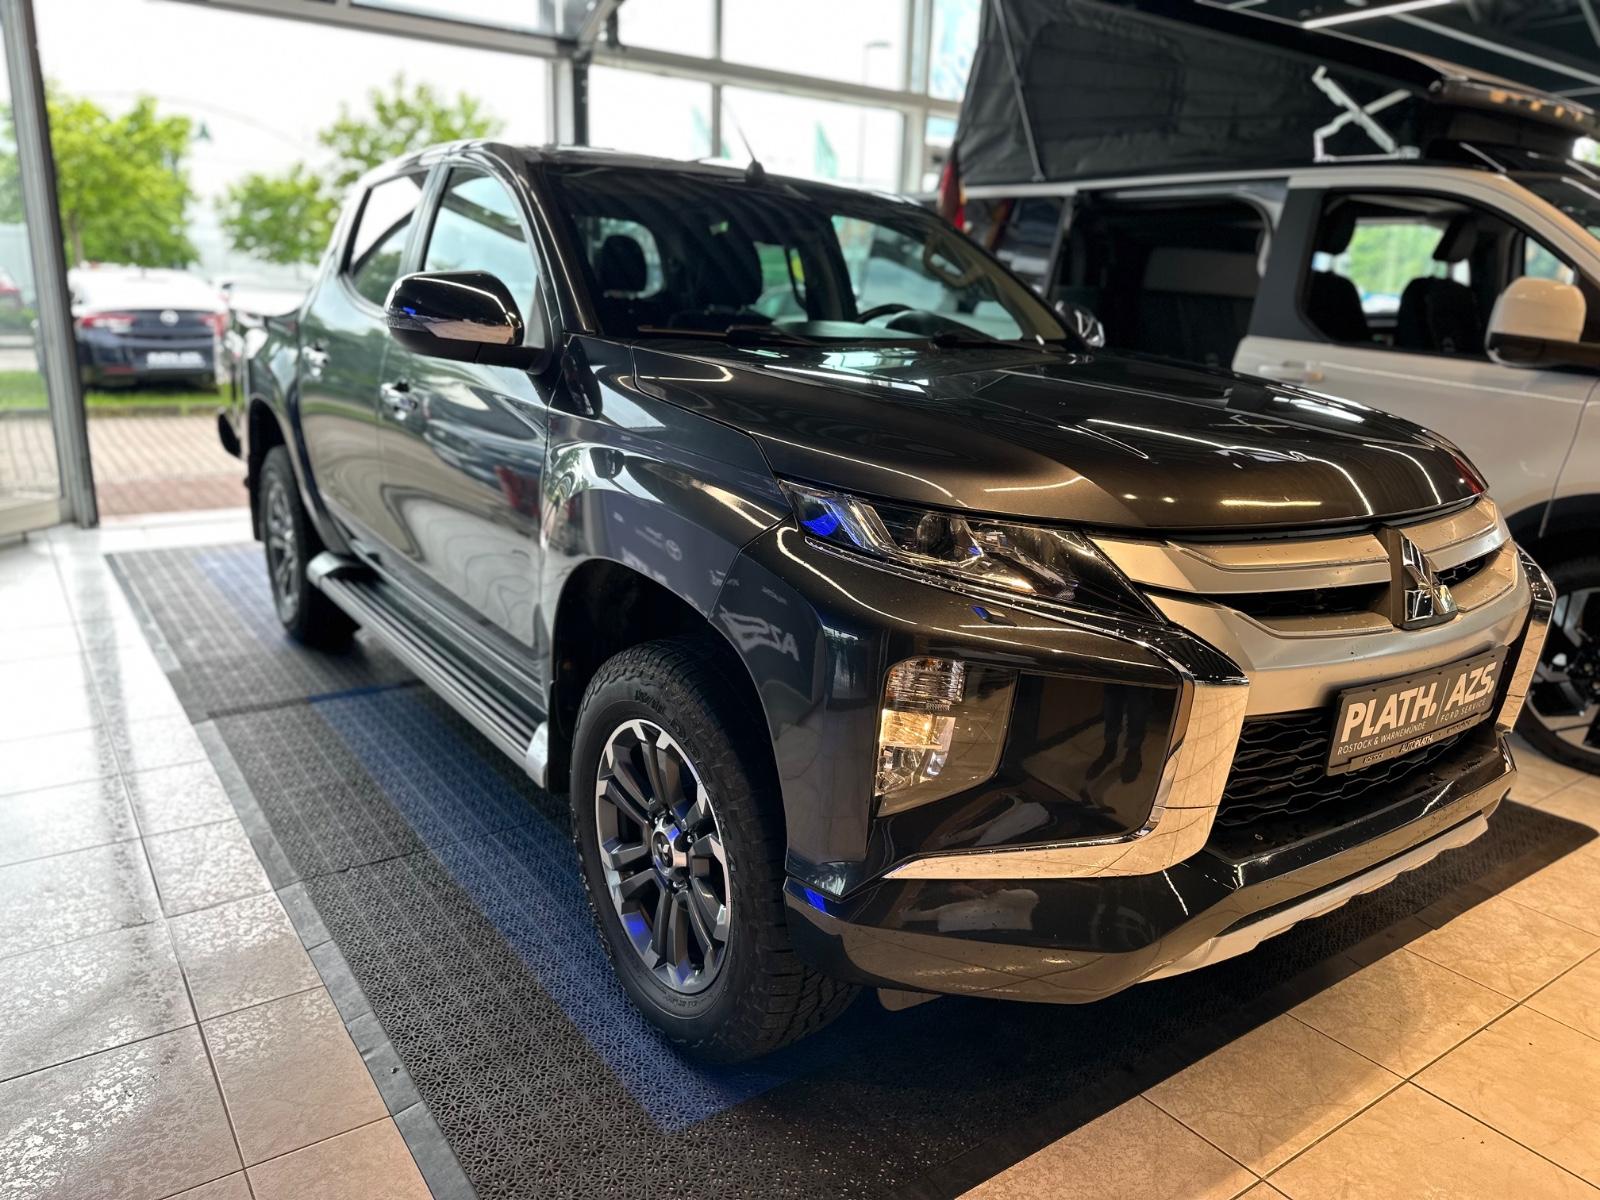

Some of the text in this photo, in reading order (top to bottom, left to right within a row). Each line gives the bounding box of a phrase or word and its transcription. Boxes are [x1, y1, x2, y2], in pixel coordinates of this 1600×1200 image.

[1440, 698, 1487, 723] FORD SERVICE
[1337, 739, 1372, 756] ROSTOCK
[1373, 736, 1379, 746] &
